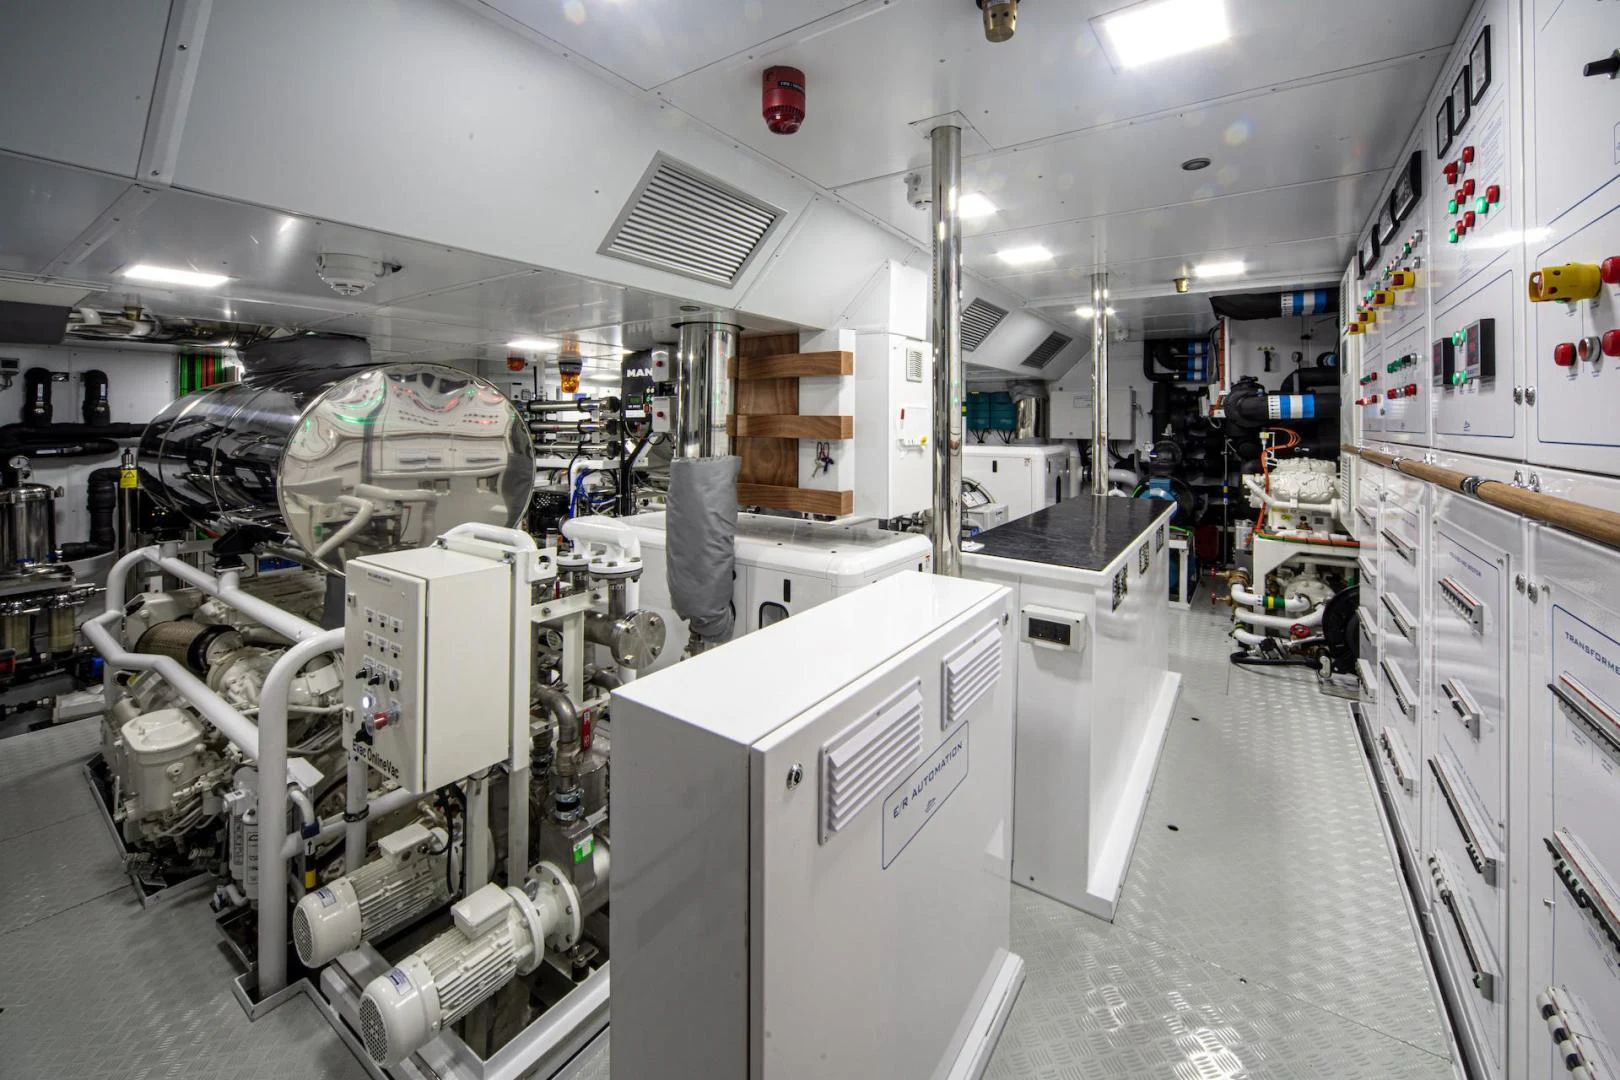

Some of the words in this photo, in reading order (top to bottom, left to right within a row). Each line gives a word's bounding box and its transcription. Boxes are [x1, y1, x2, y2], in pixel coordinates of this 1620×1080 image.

[626, 368, 653, 378] MAN
[352, 739, 367, 758] Evac
[367, 747, 399, 779] OnlineVac
[892, 797, 909, 819] E/R
[911, 741, 963, 800] AUTOMATION
